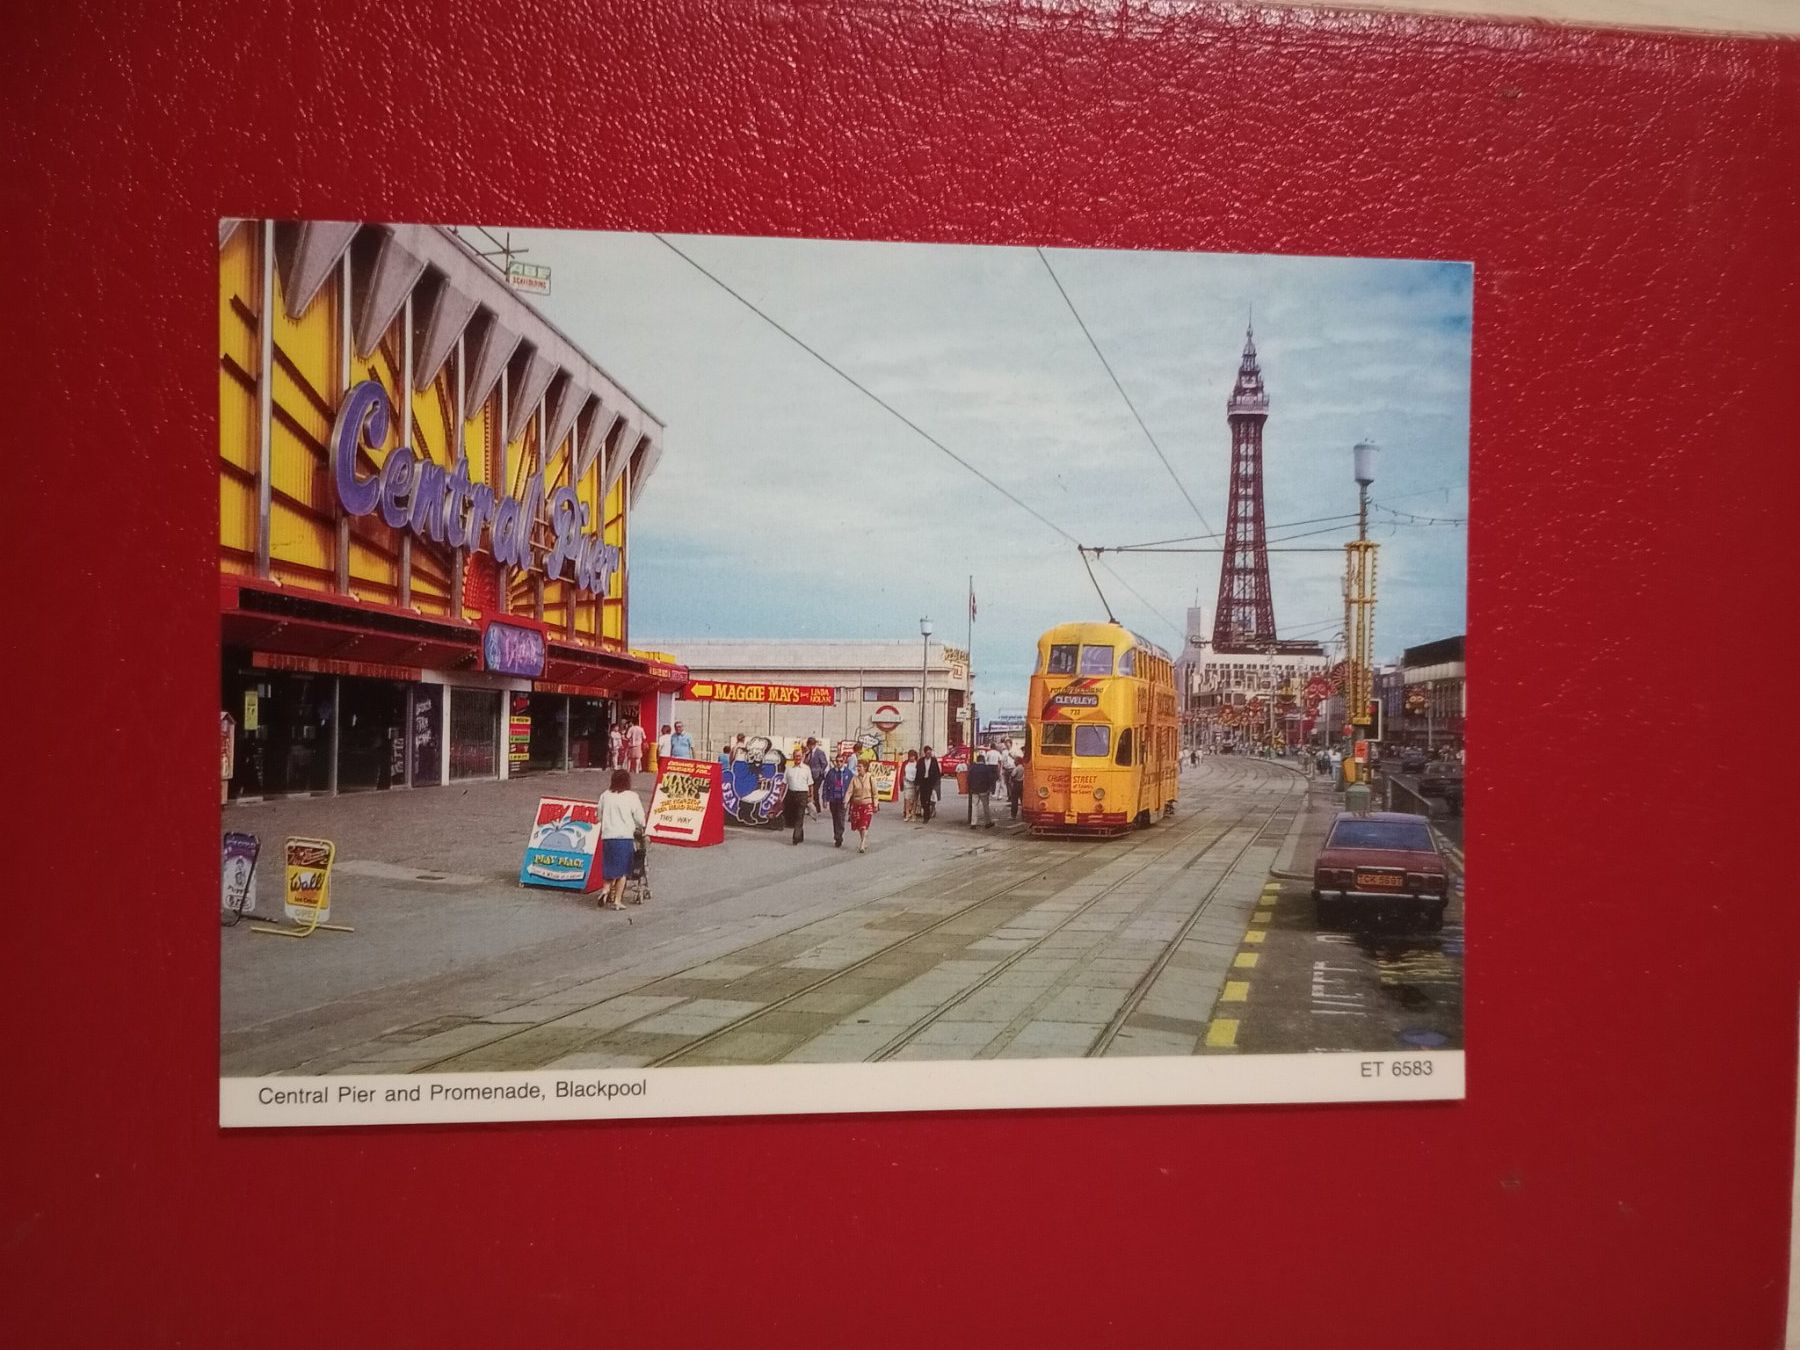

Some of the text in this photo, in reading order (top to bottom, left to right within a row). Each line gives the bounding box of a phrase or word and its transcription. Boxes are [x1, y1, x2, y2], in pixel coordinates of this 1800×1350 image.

[330, 380, 619, 596] Central Pier
[714, 683, 765, 701] MAGGIE
[768, 686, 800, 702] MAYS
[1055, 695, 1098, 705] CLEVELEYS
[661, 773, 712, 788] MAGGIE
[1073, 775, 1097, 784] STREET
[666, 782, 700, 796] MAYS
[721, 782, 737, 809] SEA
[660, 814, 693, 825] THIS WAY
[1361, 1060, 1433, 1077] ET 6583
[258, 1078, 647, 1105] Central Pier and Promenade, Blackpool
